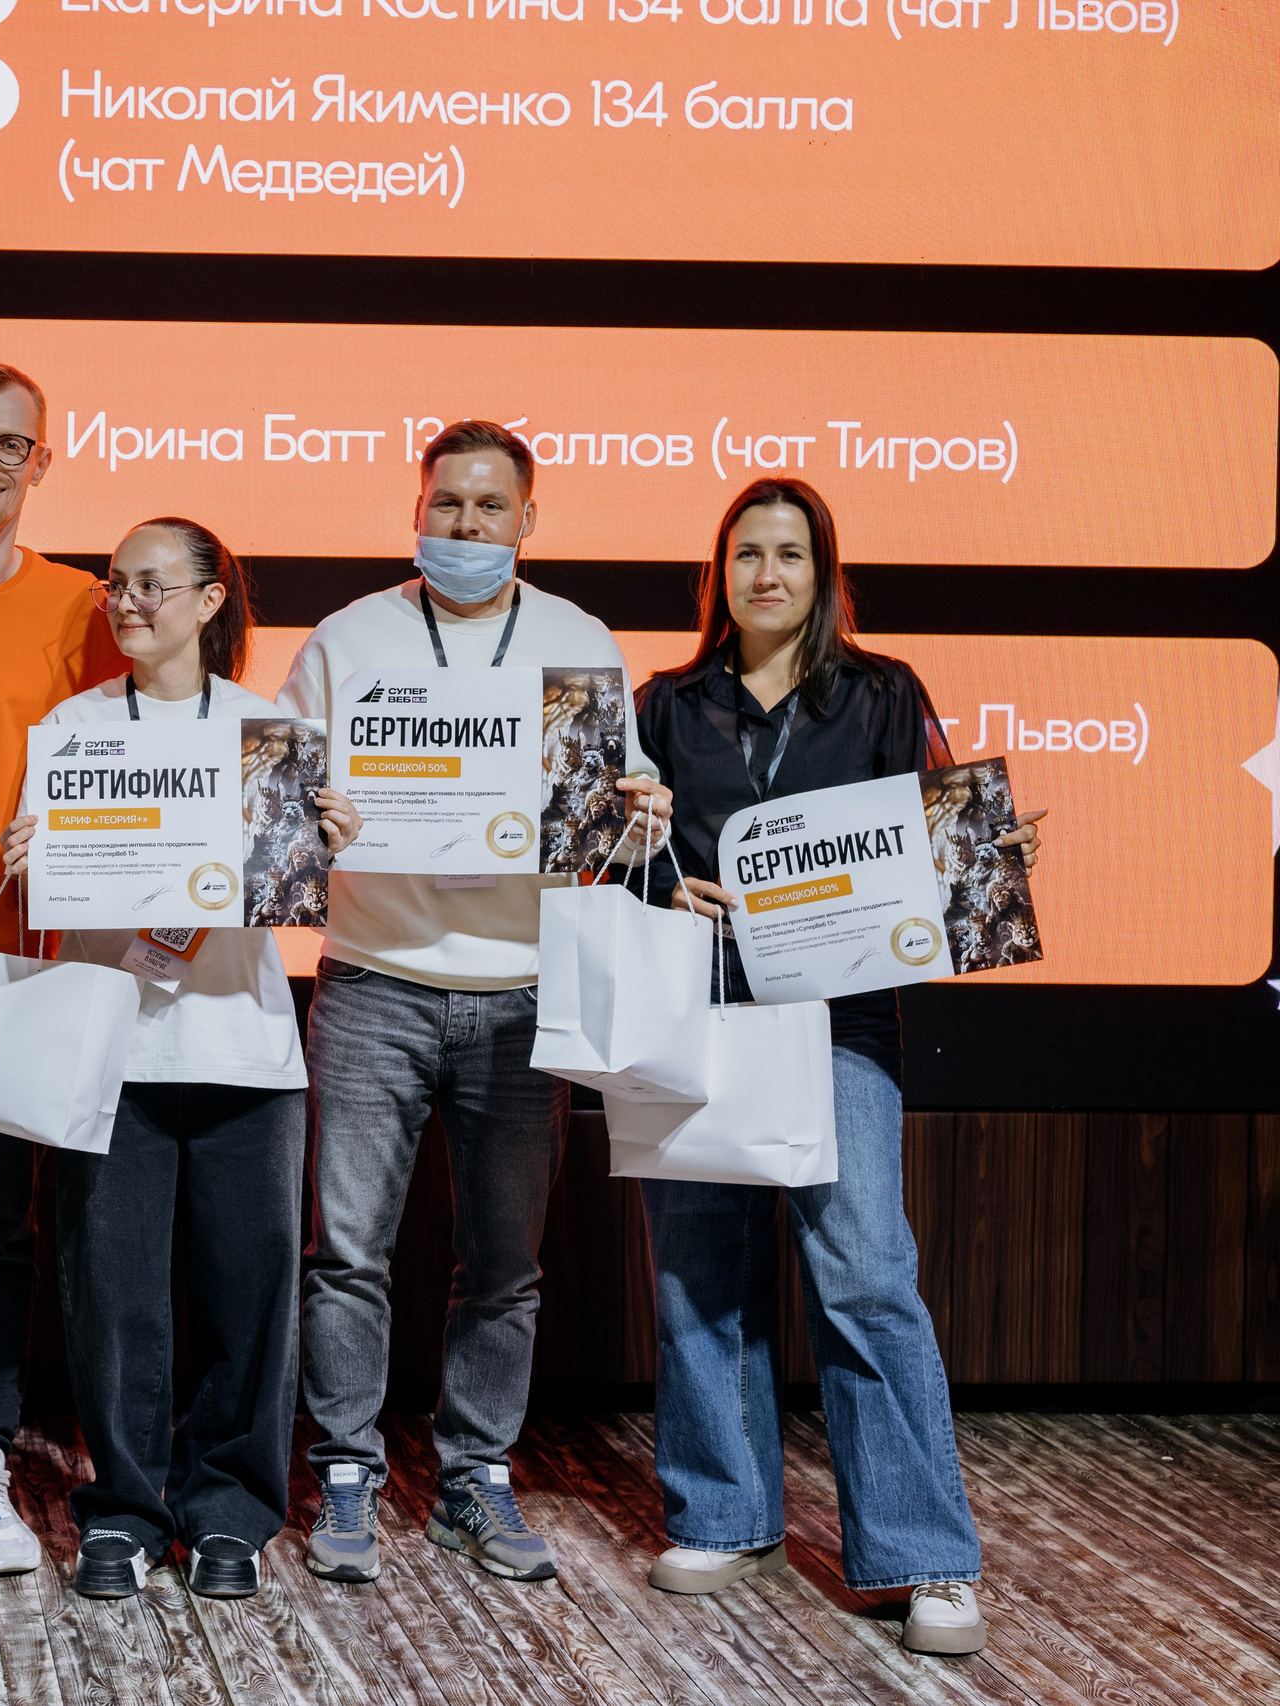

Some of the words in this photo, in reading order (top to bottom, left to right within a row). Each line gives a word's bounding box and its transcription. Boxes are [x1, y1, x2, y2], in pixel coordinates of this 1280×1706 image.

[700, 0, 868, 26] балла
[886, 0, 990, 40] (чат
[1003, 0, 1179, 46] Львов)
[61, 69, 294, 123] Николай
[312, 73, 571, 127] Якименко
[590, 80, 668, 127] 134
[684, 81, 853, 131] балла
[59, 138, 165, 202] (чат
[177, 143, 465, 209] Медведей)
[66, 411, 243, 471] Ирина
[264, 413, 386, 462] Батт
[403, 416, 471, 463] 13
[712, 416, 816, 479] (чат
[827, 420, 1018, 483] Тигров)
[350, 716, 521, 748] СЕРТИФИКАТ
[972, 702, 1148, 765] Львов)
[362, 762, 376, 772] СО
[378, 762, 426, 774] СКИДКОЙ
[428, 763, 447, 772] 50%
[47, 768, 220, 800] СЕРТИФИКАТ
[368, 797, 393, 805] Ланцова
[394, 798, 426, 806] «СуперВеб
[59, 816, 91, 825] ТАРИФ
[94, 815, 148, 824] «ТЕОРИЯ+»
[766, 814, 803, 827] СУПЕР
[767, 825, 789, 836] ВЕБ
[68, 850, 93, 858] Ланцова
[95, 850, 126, 858] «СуперВеб
[367, 841, 388, 849] Ланцов
[737, 825, 904, 885] СЕРТИФИКАТ
[68, 895, 90, 903] Ланцов
[758, 896, 773, 907] СО
[773, 885, 818, 904] СКИДКОЙ
[820, 883, 839, 894] 50%
